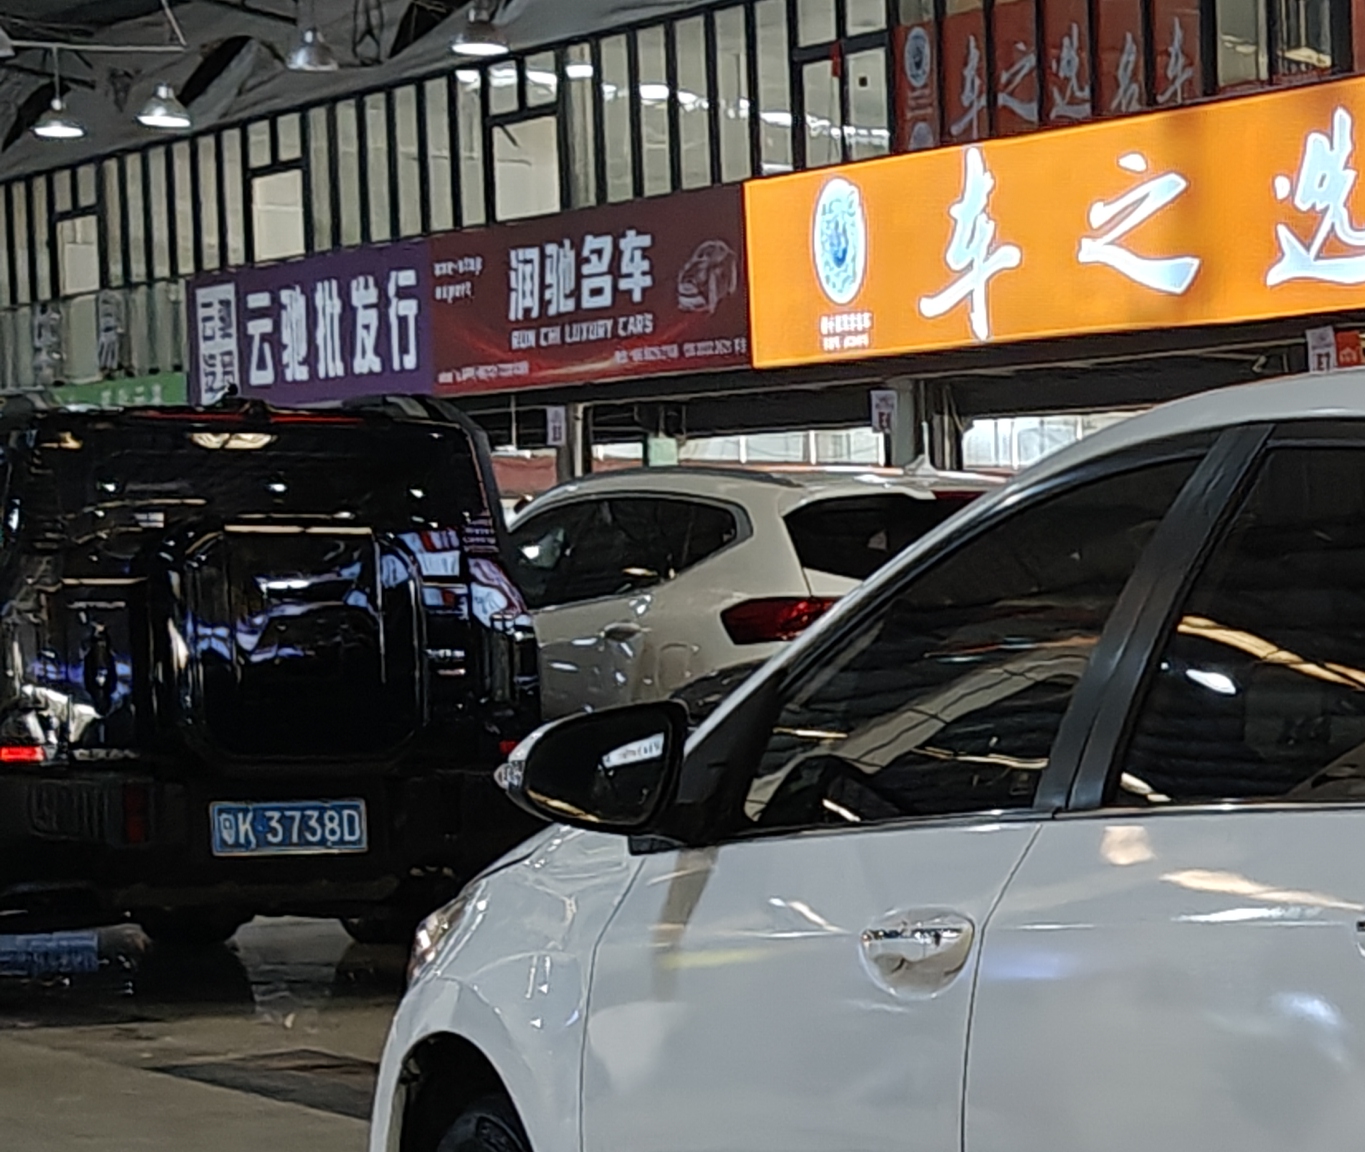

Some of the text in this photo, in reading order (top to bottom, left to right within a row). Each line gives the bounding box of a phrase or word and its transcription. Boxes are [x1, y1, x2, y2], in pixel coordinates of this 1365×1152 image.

[508, 229, 653, 321] 润驰名车
[246, 268, 420, 388] 云驰批发行
[617, 312, 654, 337] CARS
